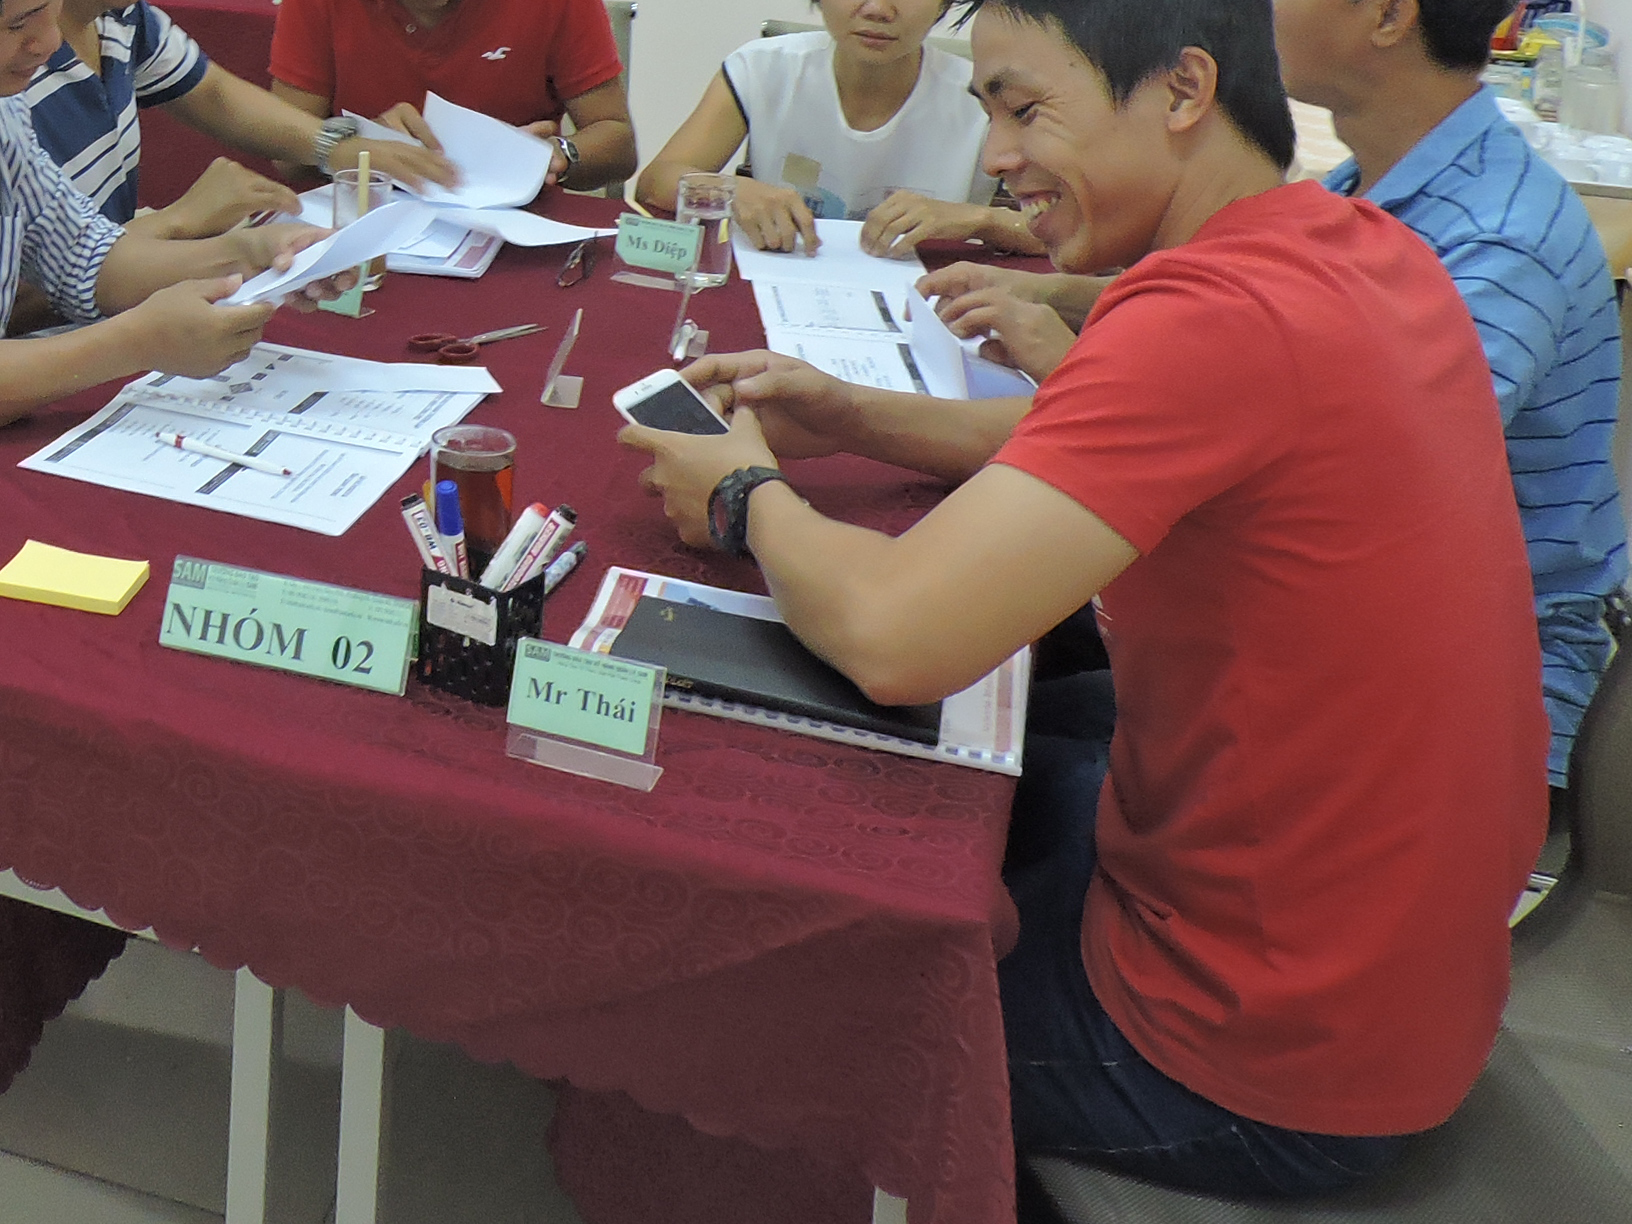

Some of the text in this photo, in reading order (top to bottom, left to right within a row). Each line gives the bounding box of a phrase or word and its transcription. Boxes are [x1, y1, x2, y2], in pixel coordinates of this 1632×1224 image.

[626, 235, 648, 250] Ms
[173, 559, 207, 585] SAM
[165, 602, 309, 661] NHÓM
[331, 634, 375, 675] 02
[526, 677, 636, 723] Mr Thái
